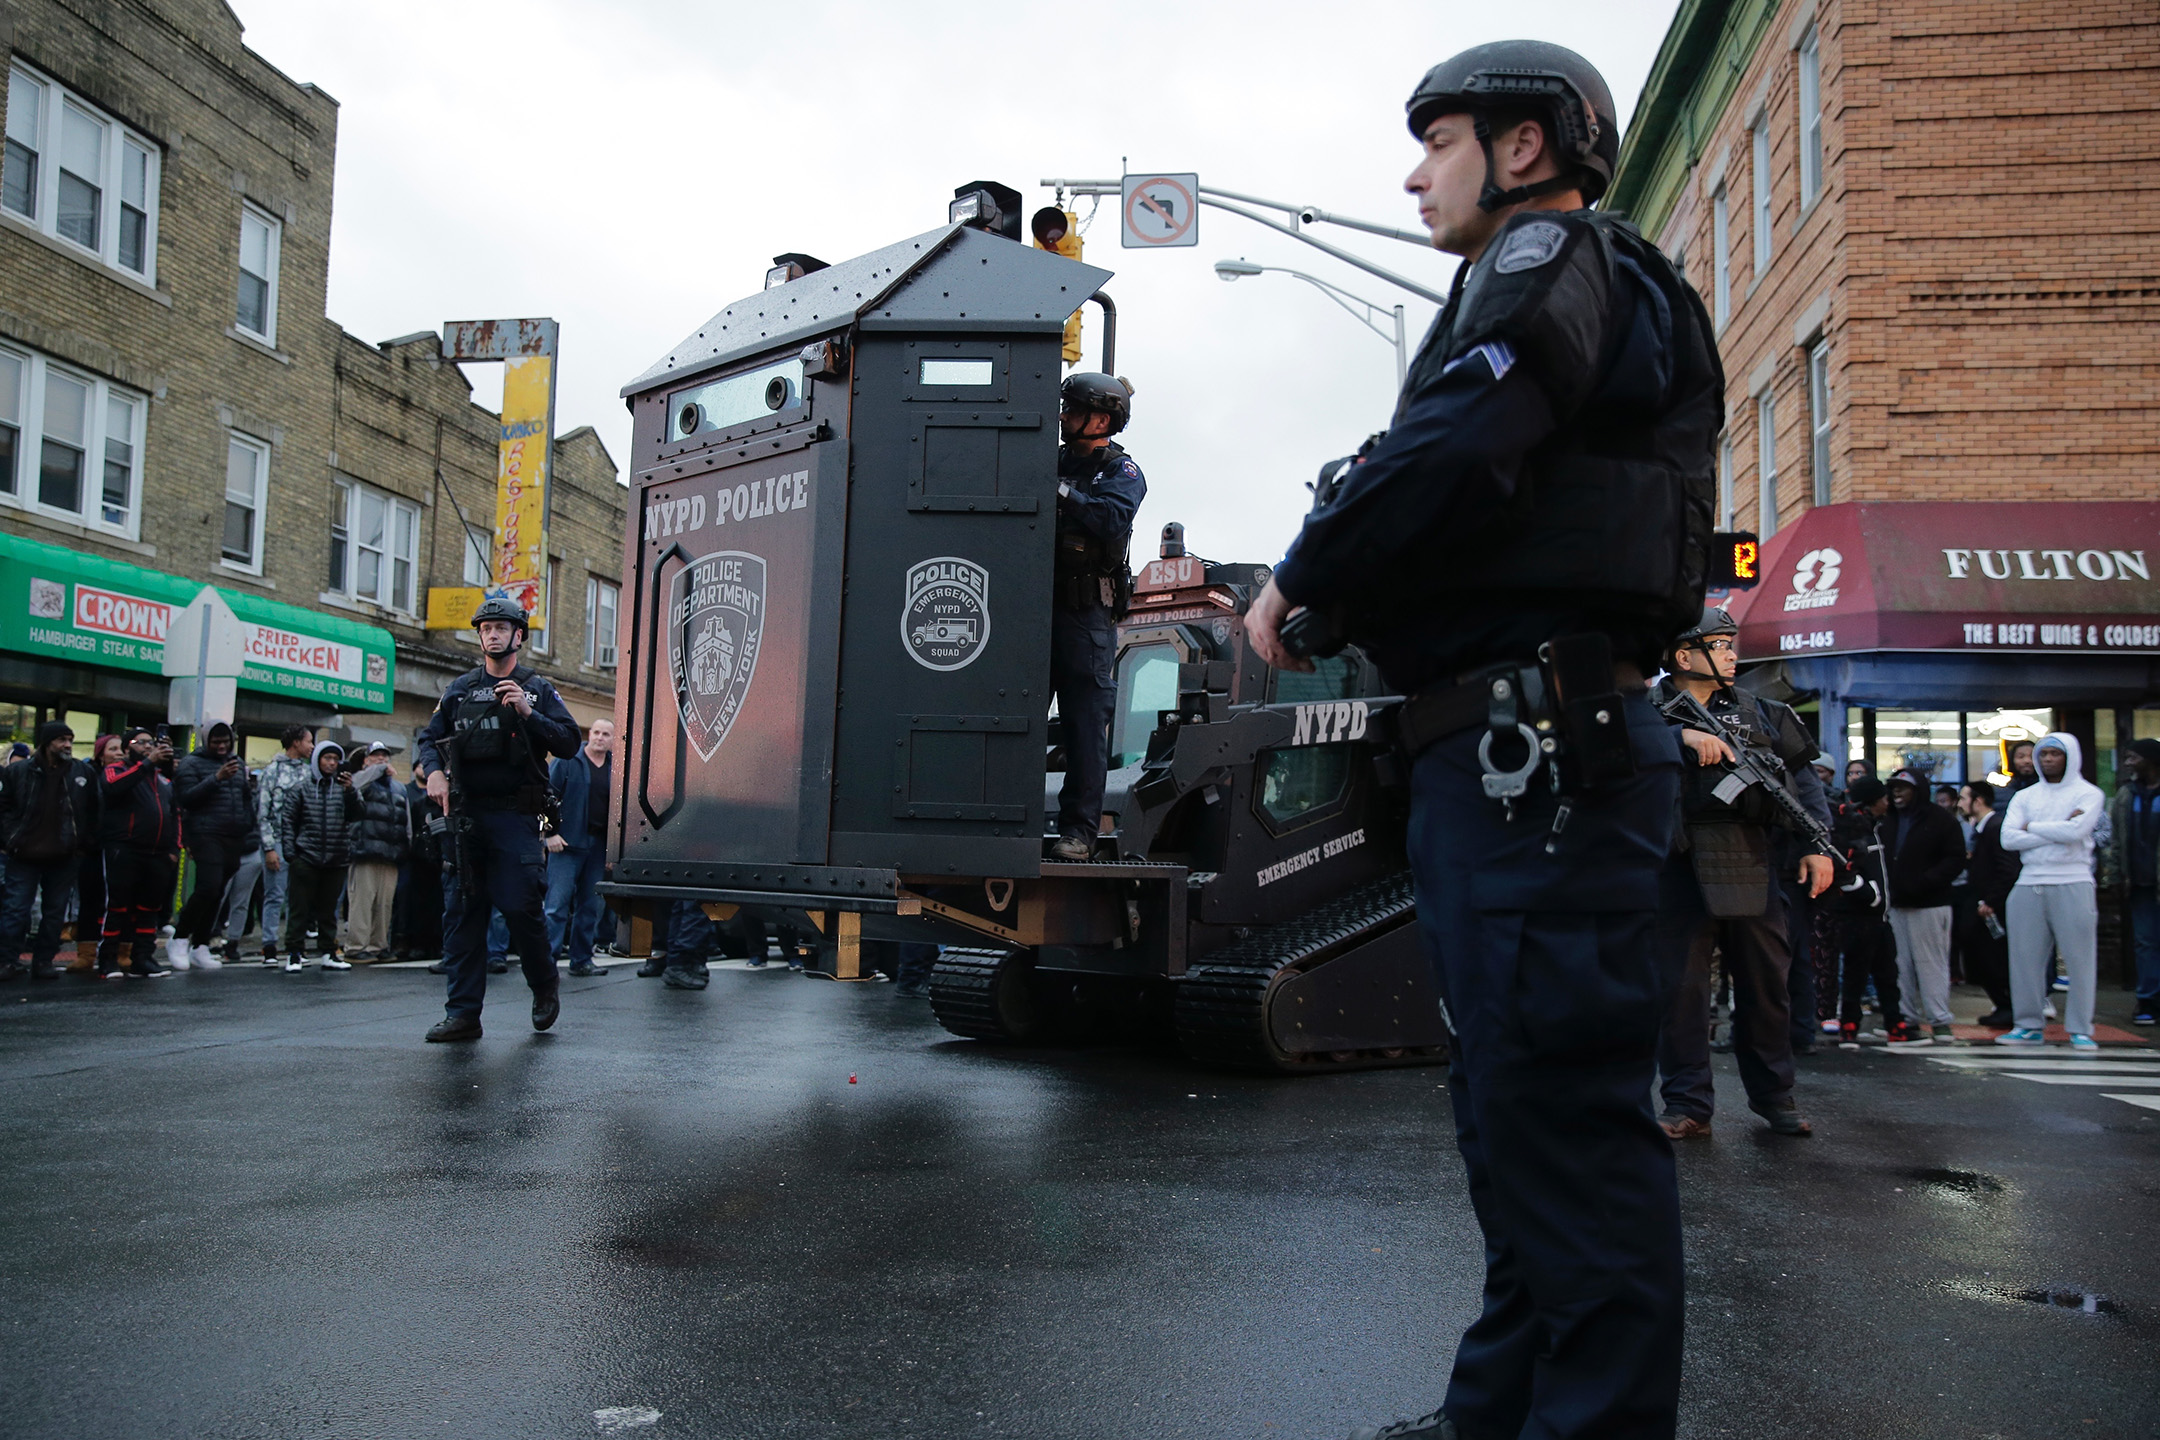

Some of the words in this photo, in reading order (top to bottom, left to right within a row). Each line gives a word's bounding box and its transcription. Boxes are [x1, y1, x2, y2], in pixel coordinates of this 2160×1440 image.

[644, 494, 706, 540] NYPD
[715, 470, 809, 526] POLICE
[692, 560, 742, 589] POLICE
[912, 563, 982, 594] POLICE
[1149, 559, 1192, 584] ESU
[1942, 548, 2150, 581] FULTON
[80, 593, 168, 639] CROWN
[673, 583, 760, 628] DEPARTMENT
[913, 587, 979, 614] EMERGENCY
[934, 605, 960, 614] NYPD
[1132, 612, 1161, 624] NYPD
[1165, 608, 1203, 621] POLICE
[1783, 595, 1839, 612] LOTTERY
[29, 627, 96, 653] HAMBURGER
[102, 639, 136, 659] STEAK
[140, 645, 165, 664] SAND
[257, 627, 299, 646] FRIED
[1780, 632, 1834, 650] 163-165
[1963, 623, 1994, 644] THE
[1998, 624, 2035, 645] BEST
[2040, 624, 2082, 646] WINE
[2086, 625, 2099, 646] &
[252, 640, 341, 672] CHICKEN
[931, 648, 959, 657] SQUAD
[276, 672, 294, 687] FISH
[295, 675, 326, 695] BURGER,
[327, 682, 340, 696] ICE
[368, 692, 385, 704] SODA
[472, 689, 495, 697] POLIC
[672, 646, 687, 693] CITY
[683, 700, 697, 723] OF
[713, 693, 738, 738] NEW
[735, 628, 758, 684] YORK
[1291, 701, 1369, 746] NYPD
[1256, 846, 1321, 888] EMERGENCY
[1322, 828, 1366, 859] SERVICE
